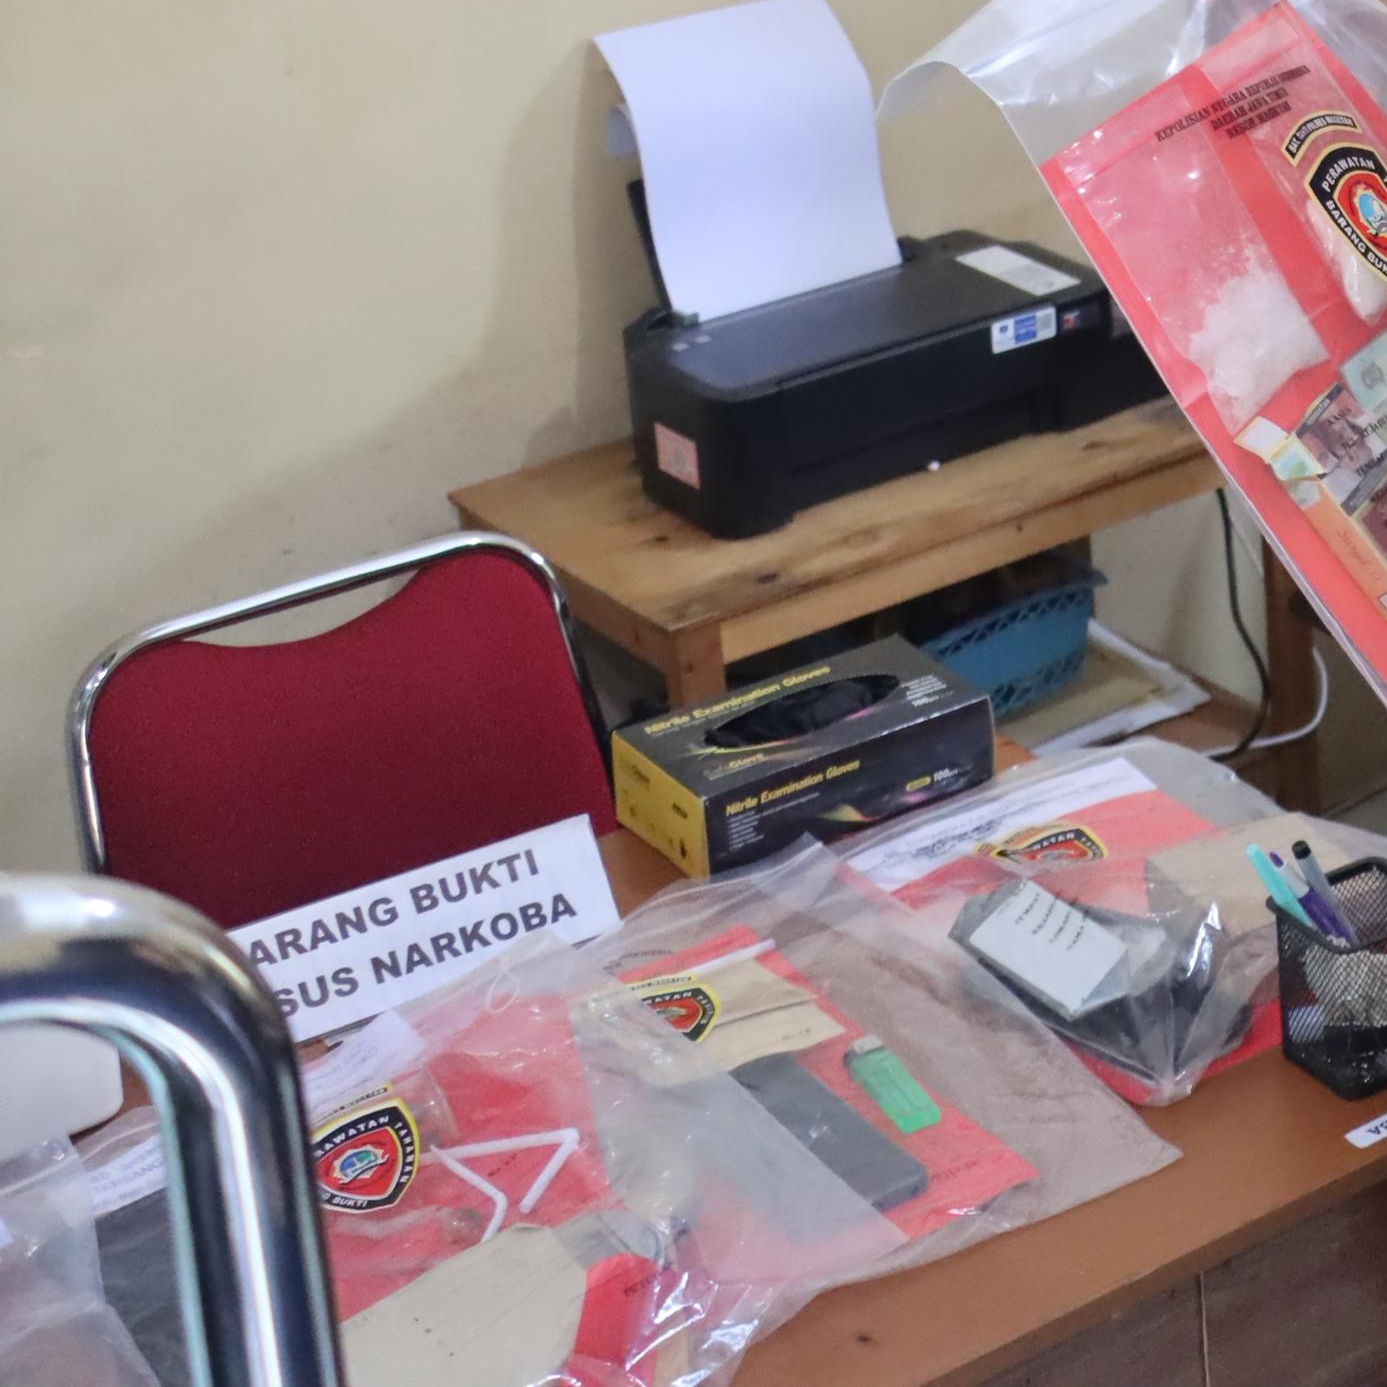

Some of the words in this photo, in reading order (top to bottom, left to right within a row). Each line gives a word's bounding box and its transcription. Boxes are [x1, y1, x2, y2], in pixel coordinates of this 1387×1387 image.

[1154, 104, 1212, 142] KEPOLISIAN
[1210, 90, 1247, 114] NEGARA
[1210, 106, 1249, 131] DAERAH
[1247, 96, 1270, 113] JAWA
[1321, 157, 1376, 193] PERAWATAN
[1325, 199, 1367, 254] BARANG
[644, 714, 691, 736] Nitrile
[691, 683, 782, 720] Examination
[781, 666, 831, 688] Gloves
[725, 795, 759, 818] Nitrile
[759, 772, 824, 805] Examination
[825, 760, 861, 781] Gloves
[249, 896, 400, 968] ARANG
[409, 848, 540, 916] BUKTI
[275, 966, 360, 1017] SUS
[370, 892, 578, 985] NARKOBA
[394, 1120, 417, 1184] TAHANAN
[331, 1195, 369, 1209] BUKTI
